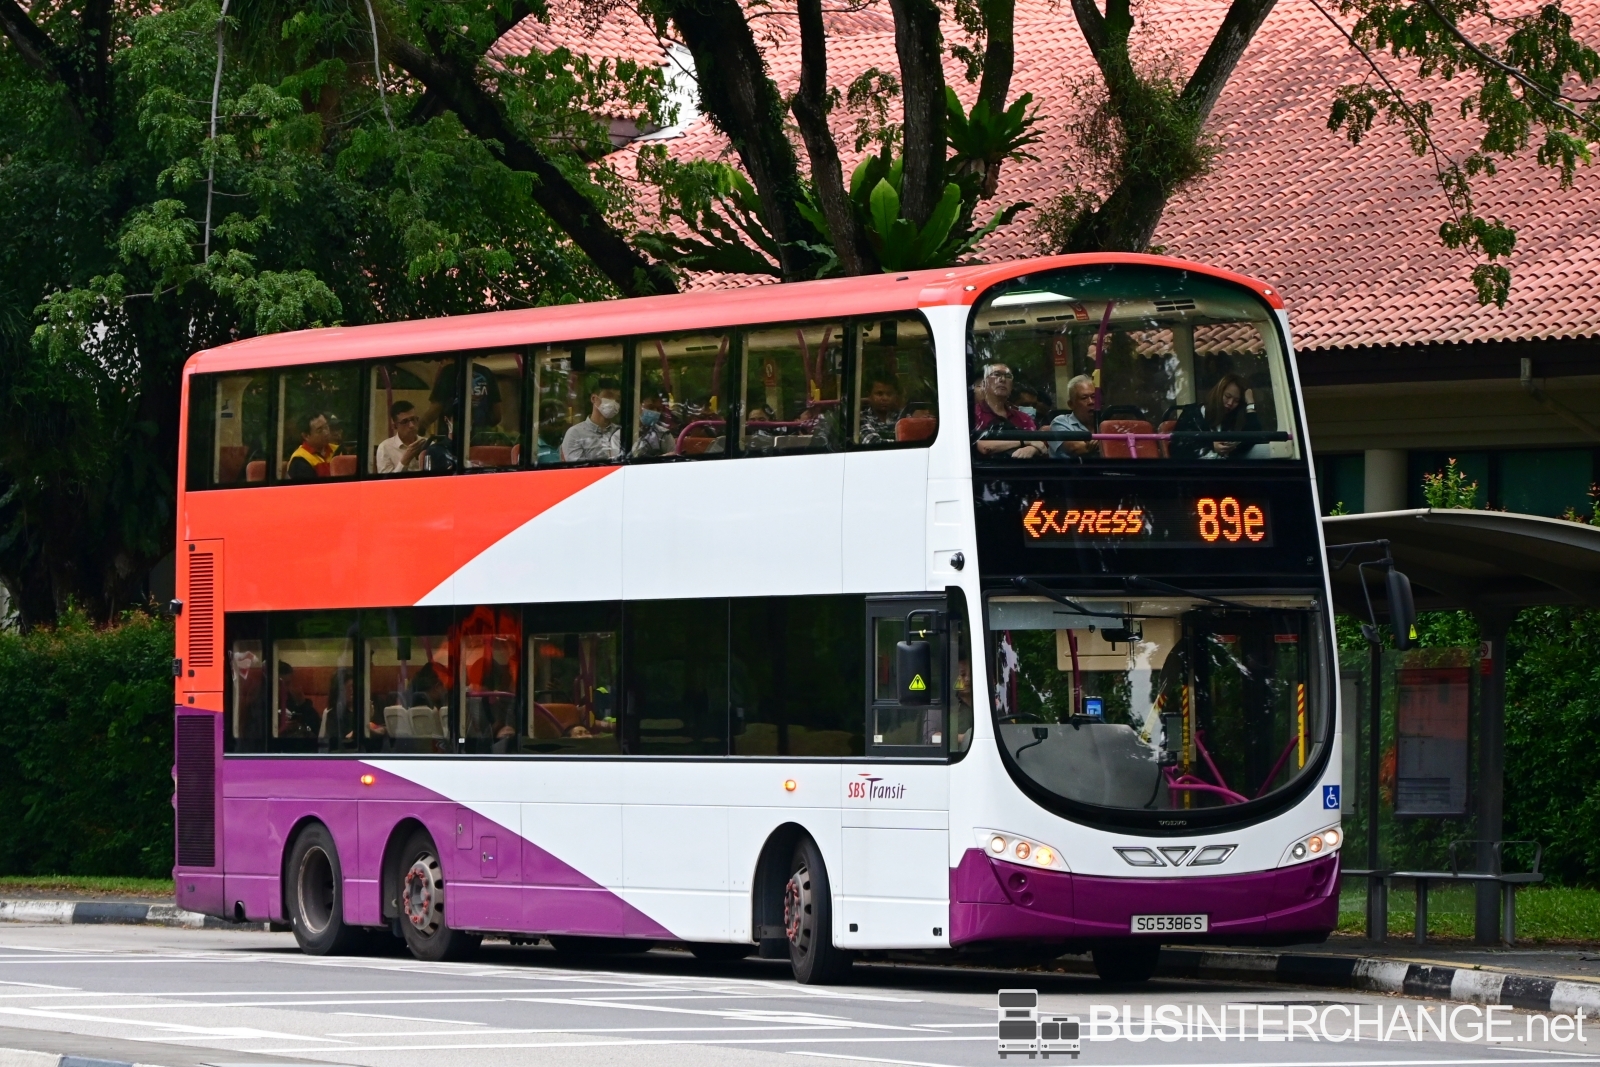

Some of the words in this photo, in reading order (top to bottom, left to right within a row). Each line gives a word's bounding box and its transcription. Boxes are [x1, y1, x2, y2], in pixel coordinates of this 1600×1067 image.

[1023, 501, 1143, 537] EXPRESS
[1197, 497, 1265, 542] 89e
[848, 782, 865, 798] SBS
[865, 778, 907, 801] Transit
[1137, 917, 1202, 930] SG5386S
